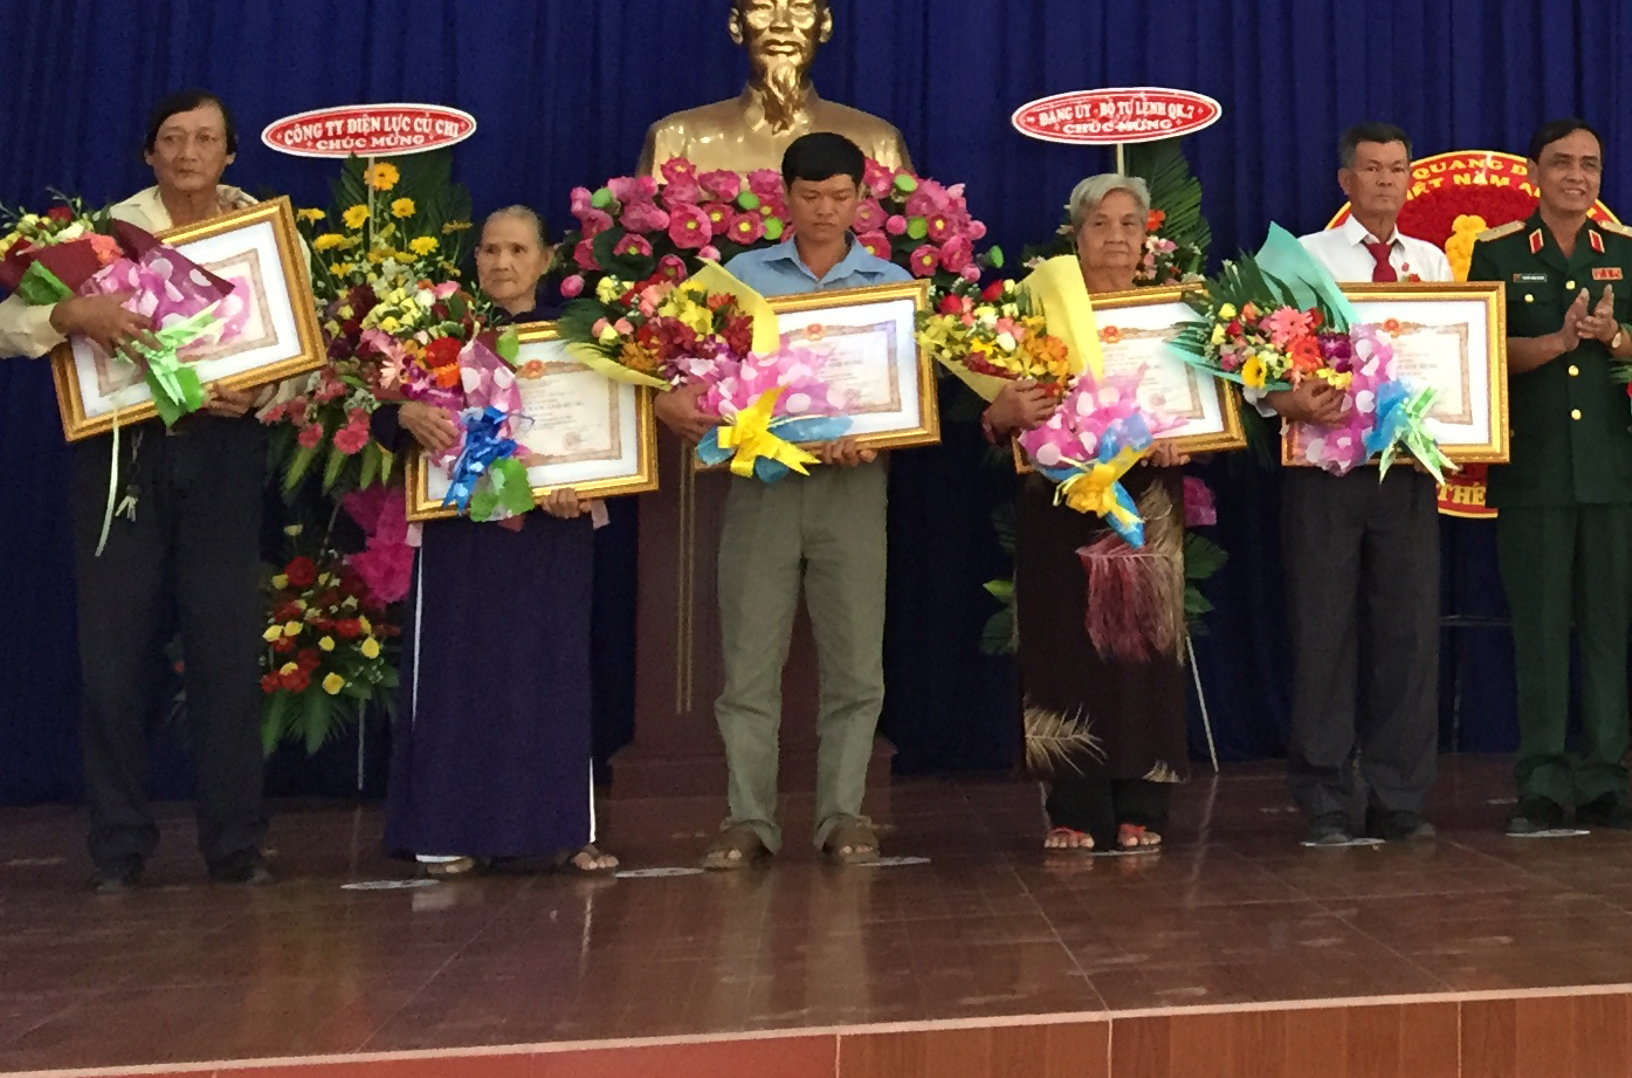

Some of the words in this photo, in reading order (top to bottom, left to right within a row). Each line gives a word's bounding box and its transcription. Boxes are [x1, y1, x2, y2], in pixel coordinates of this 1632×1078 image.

[284, 123, 323, 145] CÔNG
[325, 119, 345, 136] TY
[346, 114, 381, 136] ĐIỆN
[384, 113, 411, 136] LỰC
[316, 136, 367, 150] CHÚC
[1412, 158, 1504, 180] QUANG
[1406, 176, 1444, 200] IỆT
